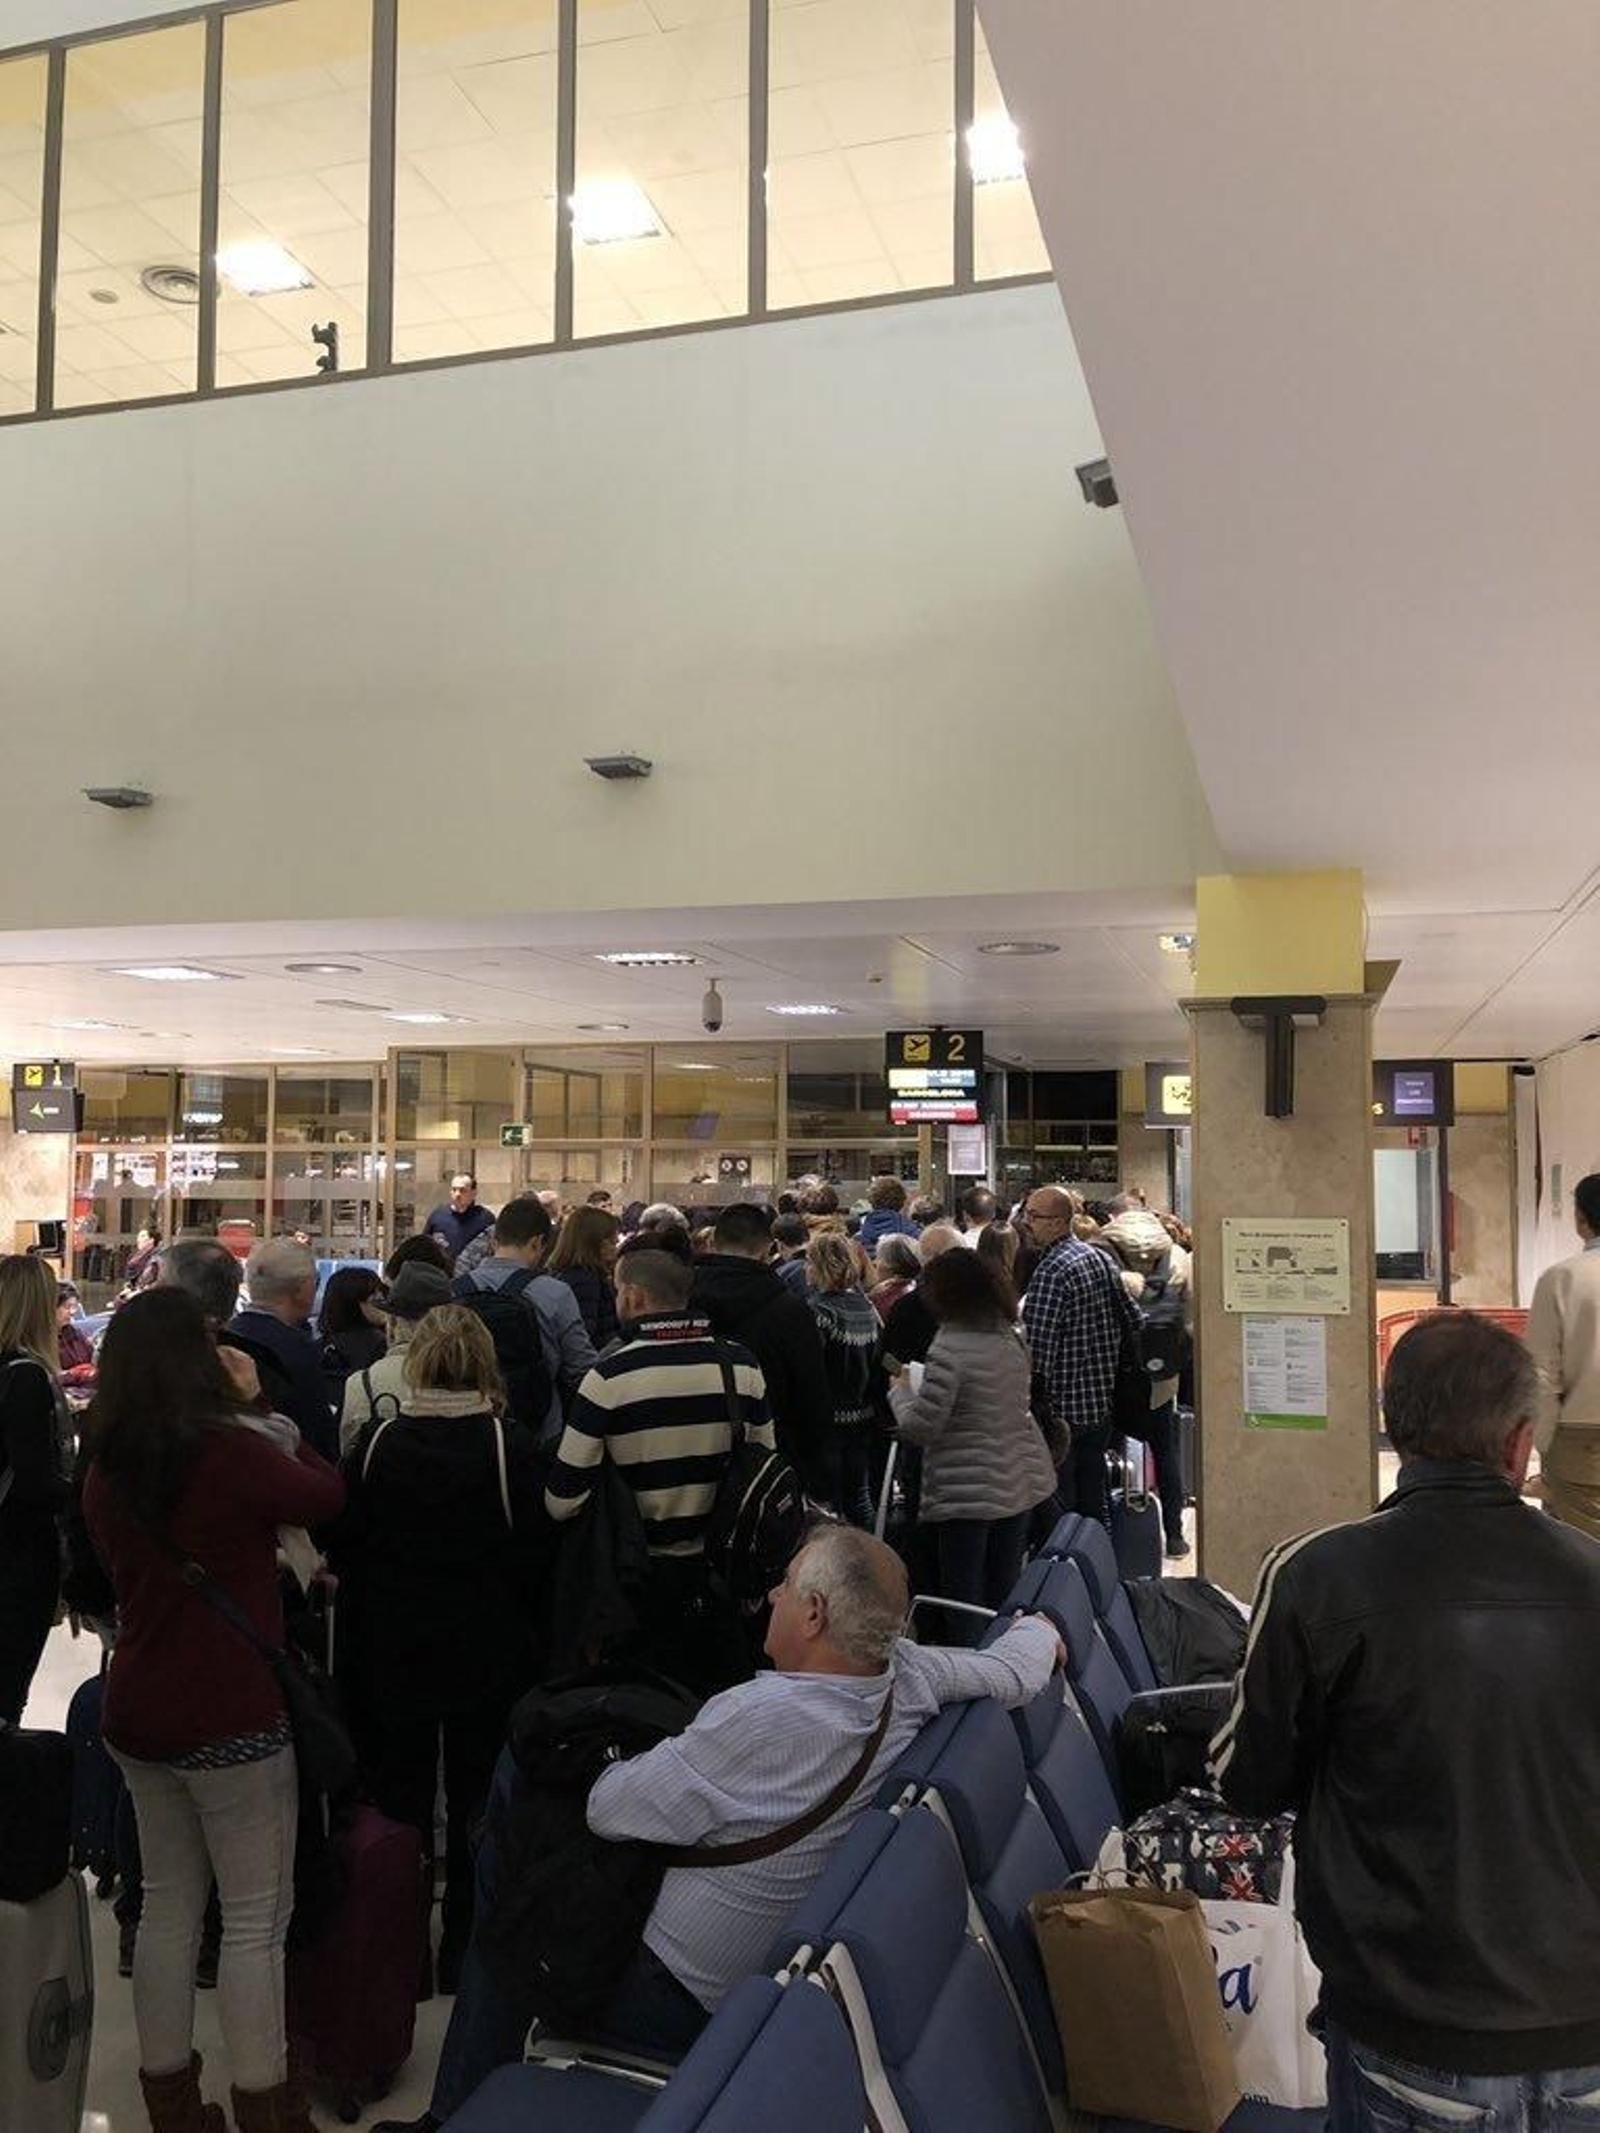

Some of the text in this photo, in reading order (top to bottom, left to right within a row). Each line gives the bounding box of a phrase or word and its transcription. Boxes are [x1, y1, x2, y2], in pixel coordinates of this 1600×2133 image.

[947, 1034, 965, 1061] 2
[53, 1065, 63, 1086] 1
[1212, 1946, 1259, 2014] a
